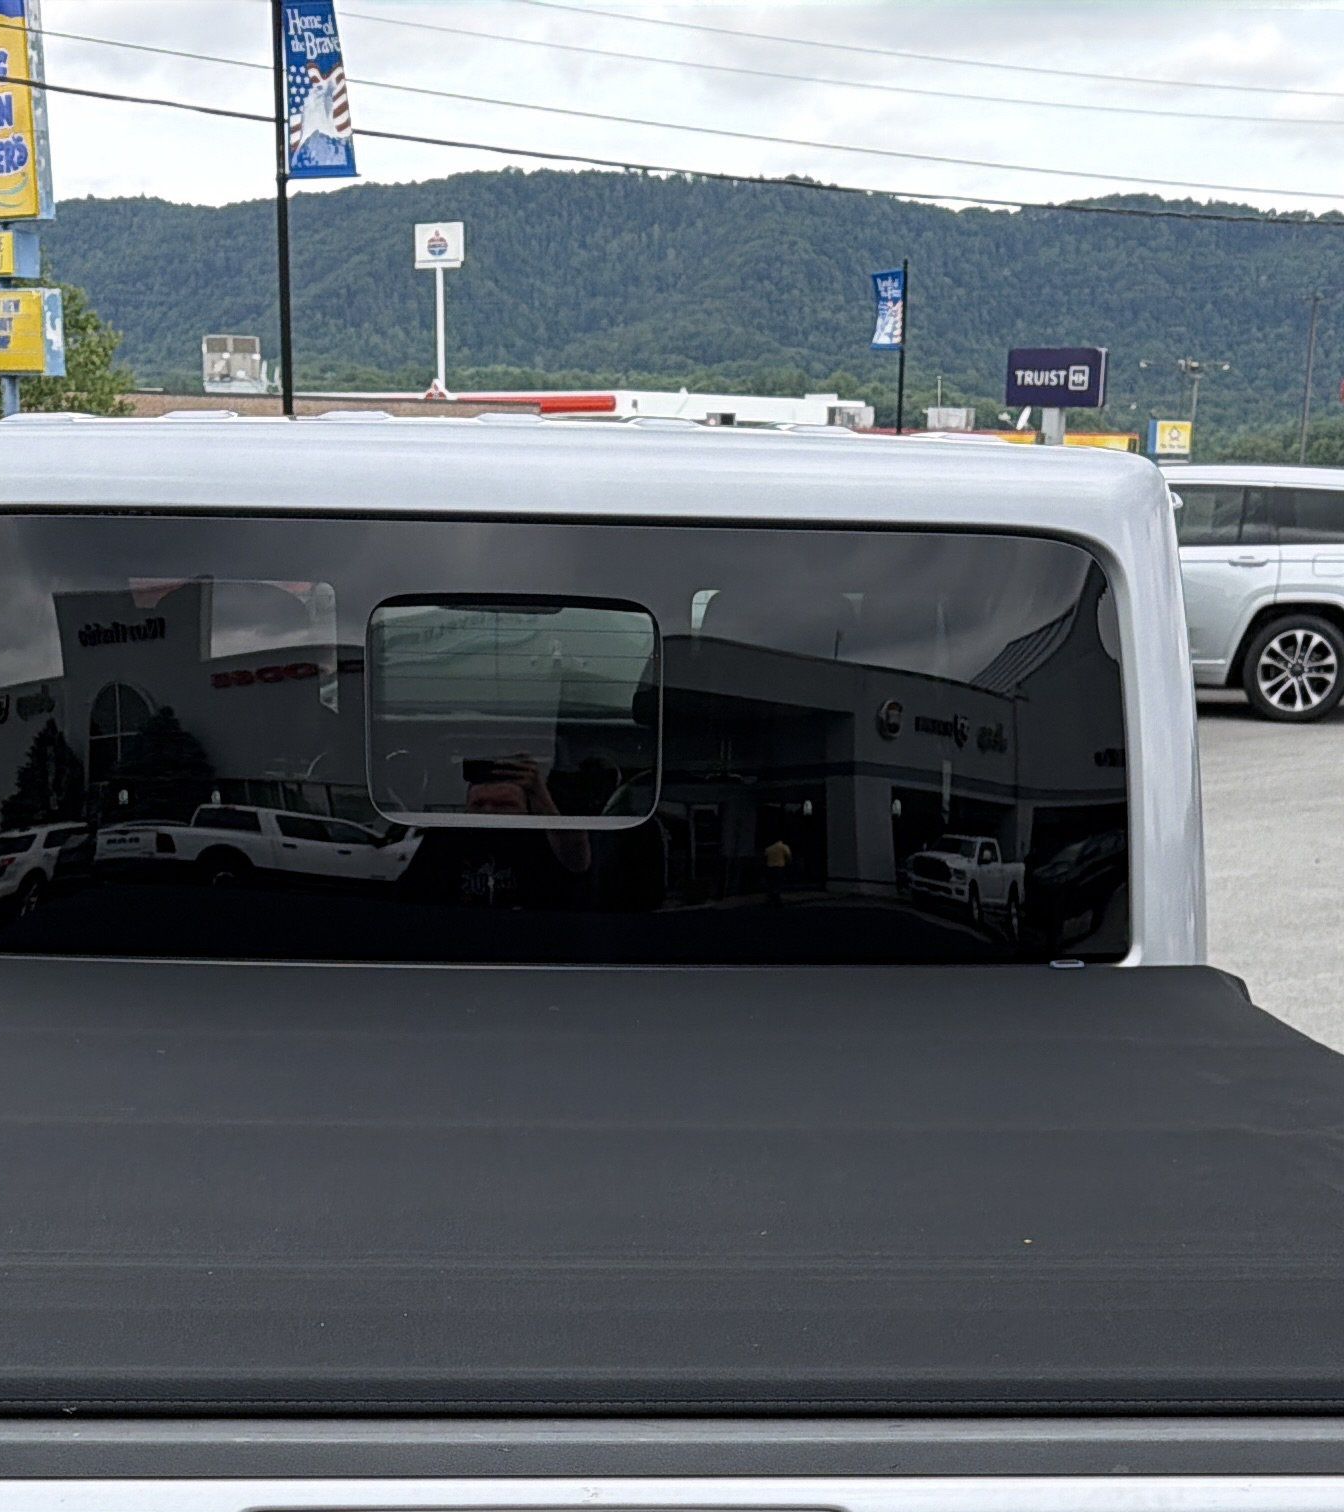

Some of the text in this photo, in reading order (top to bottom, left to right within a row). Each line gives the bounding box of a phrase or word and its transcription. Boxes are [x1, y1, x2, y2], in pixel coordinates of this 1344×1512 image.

[286, 8, 334, 35] Home of
[291, 32, 341, 60] the Brave
[1015, 369, 1067, 386] TRUIST
